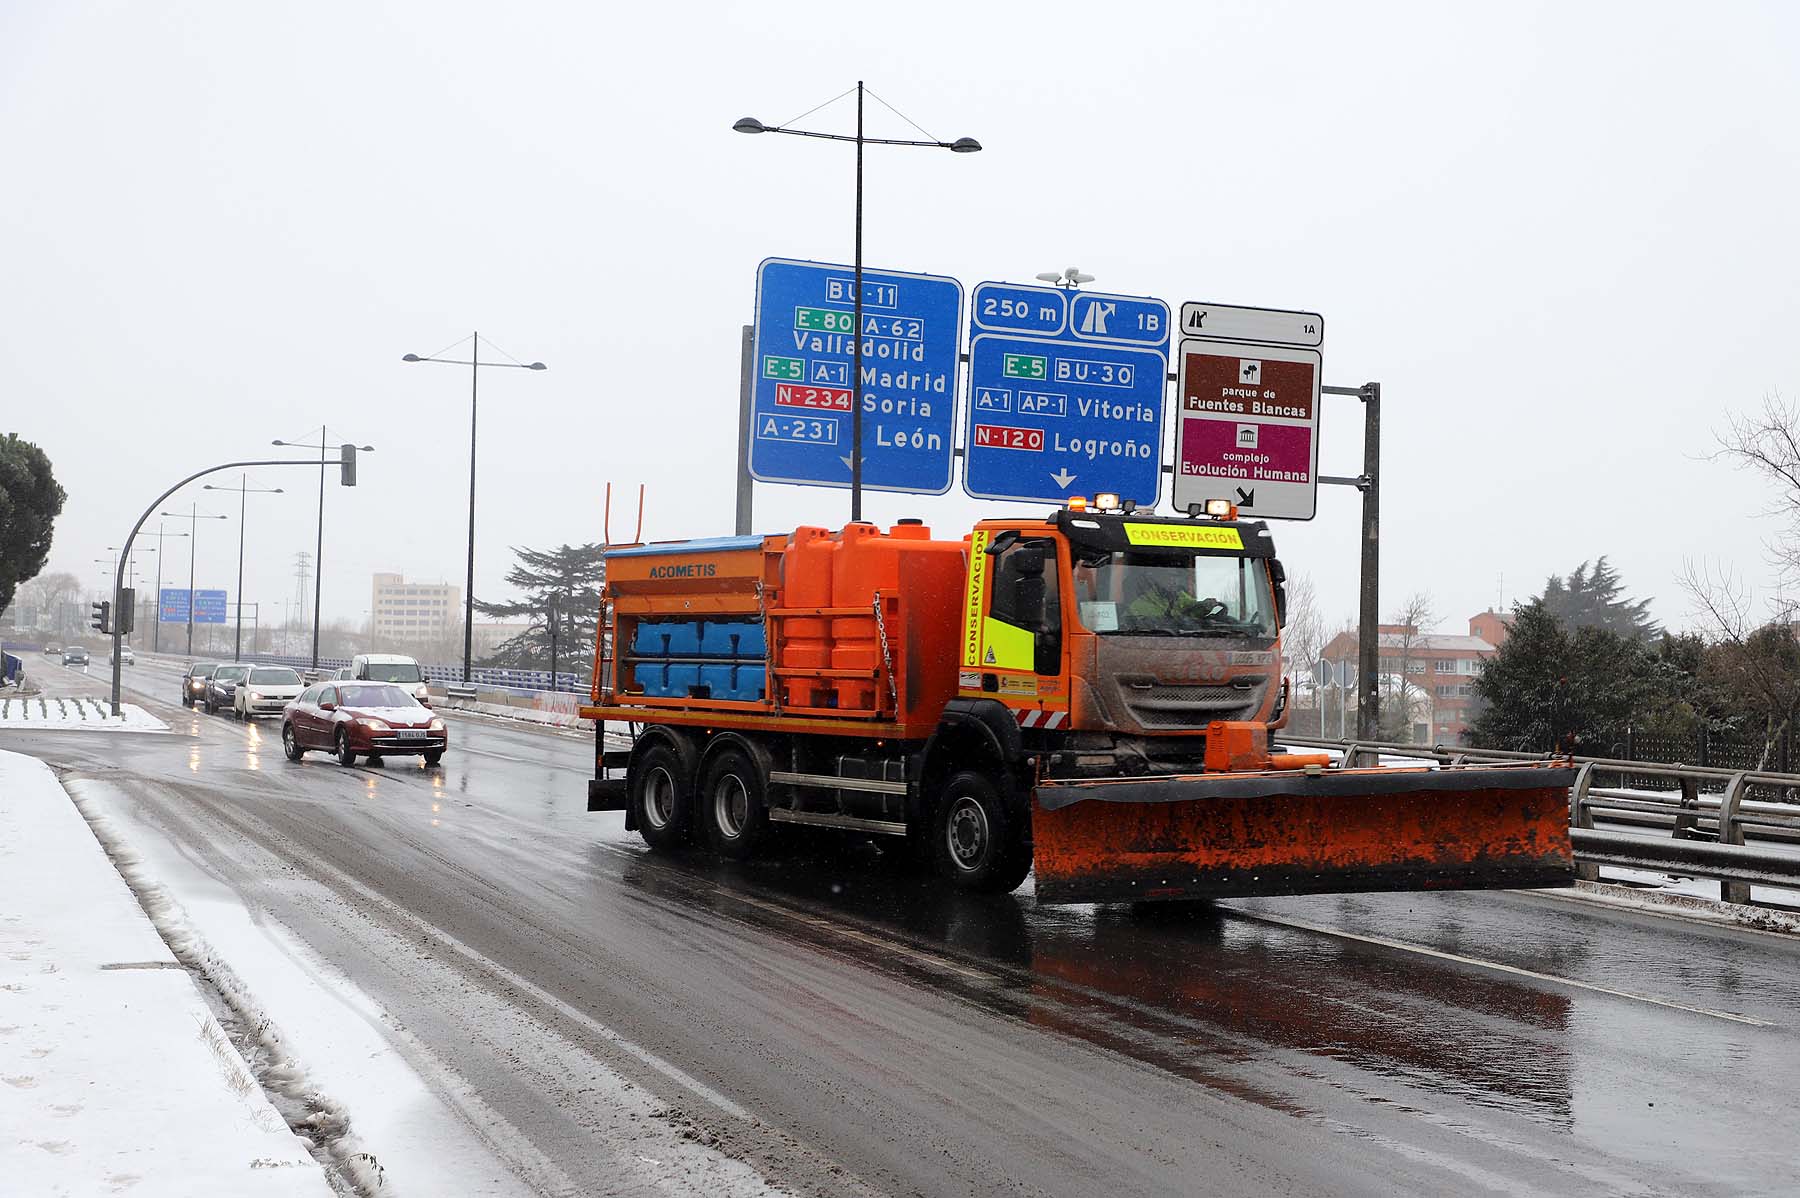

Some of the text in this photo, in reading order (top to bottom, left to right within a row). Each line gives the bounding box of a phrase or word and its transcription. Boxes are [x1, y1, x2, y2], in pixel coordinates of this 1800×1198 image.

[983, 298, 1056, 321] 250 m
[798, 310, 920, 338] E-80 A-62
[1137, 314, 1159, 331] 1B
[1303, 324, 1315, 335] 1A
[793, 330, 924, 362] Valladolid
[766, 359, 945, 393] E-5 A-1 Madrid
[1006, 357, 1131, 384] E-5 BU-30
[778, 386, 931, 417] N-234 Soria
[1222, 387, 1276, 400] parque de
[979, 391, 1154, 422] A-1 AP-1 Vitoria
[1189, 396, 1306, 417] Fuentes Blancas
[763, 418, 941, 450] A-231 León
[977, 428, 1151, 460] N-120 Logroño
[1222, 452, 1270, 464] complejo
[1182, 461, 1308, 482] Evolución Humana
[649, 563, 716, 578] ACOMETIS
